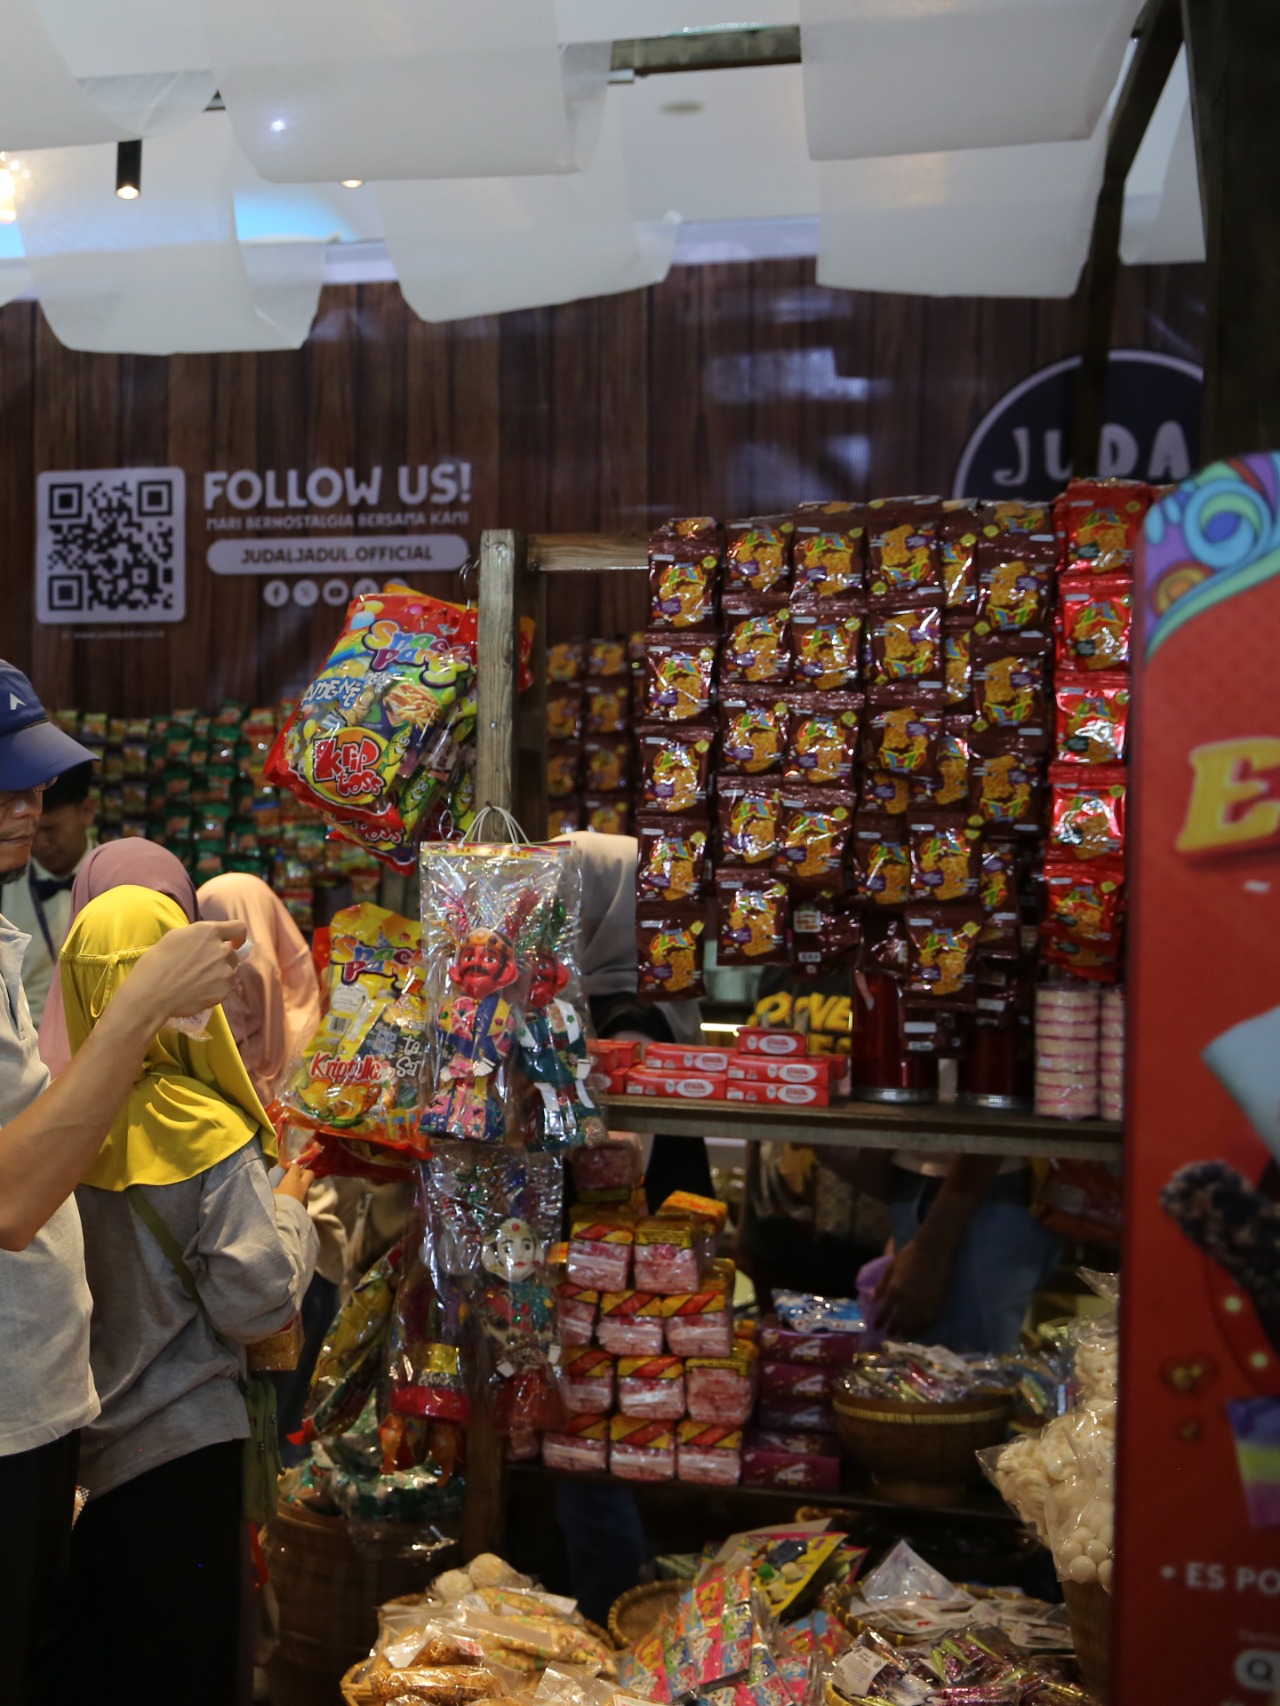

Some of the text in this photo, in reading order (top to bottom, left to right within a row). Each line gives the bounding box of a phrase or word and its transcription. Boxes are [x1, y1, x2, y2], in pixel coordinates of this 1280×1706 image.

[204, 461, 471, 511] FOLLOW US!
[206, 510, 469, 531] MARI BERNOSTALGIA BERSAMA KAMI
[241, 545, 432, 564] JUDALJADUL.OFFICIAL
[1186, 1561, 1226, 1590] ES
